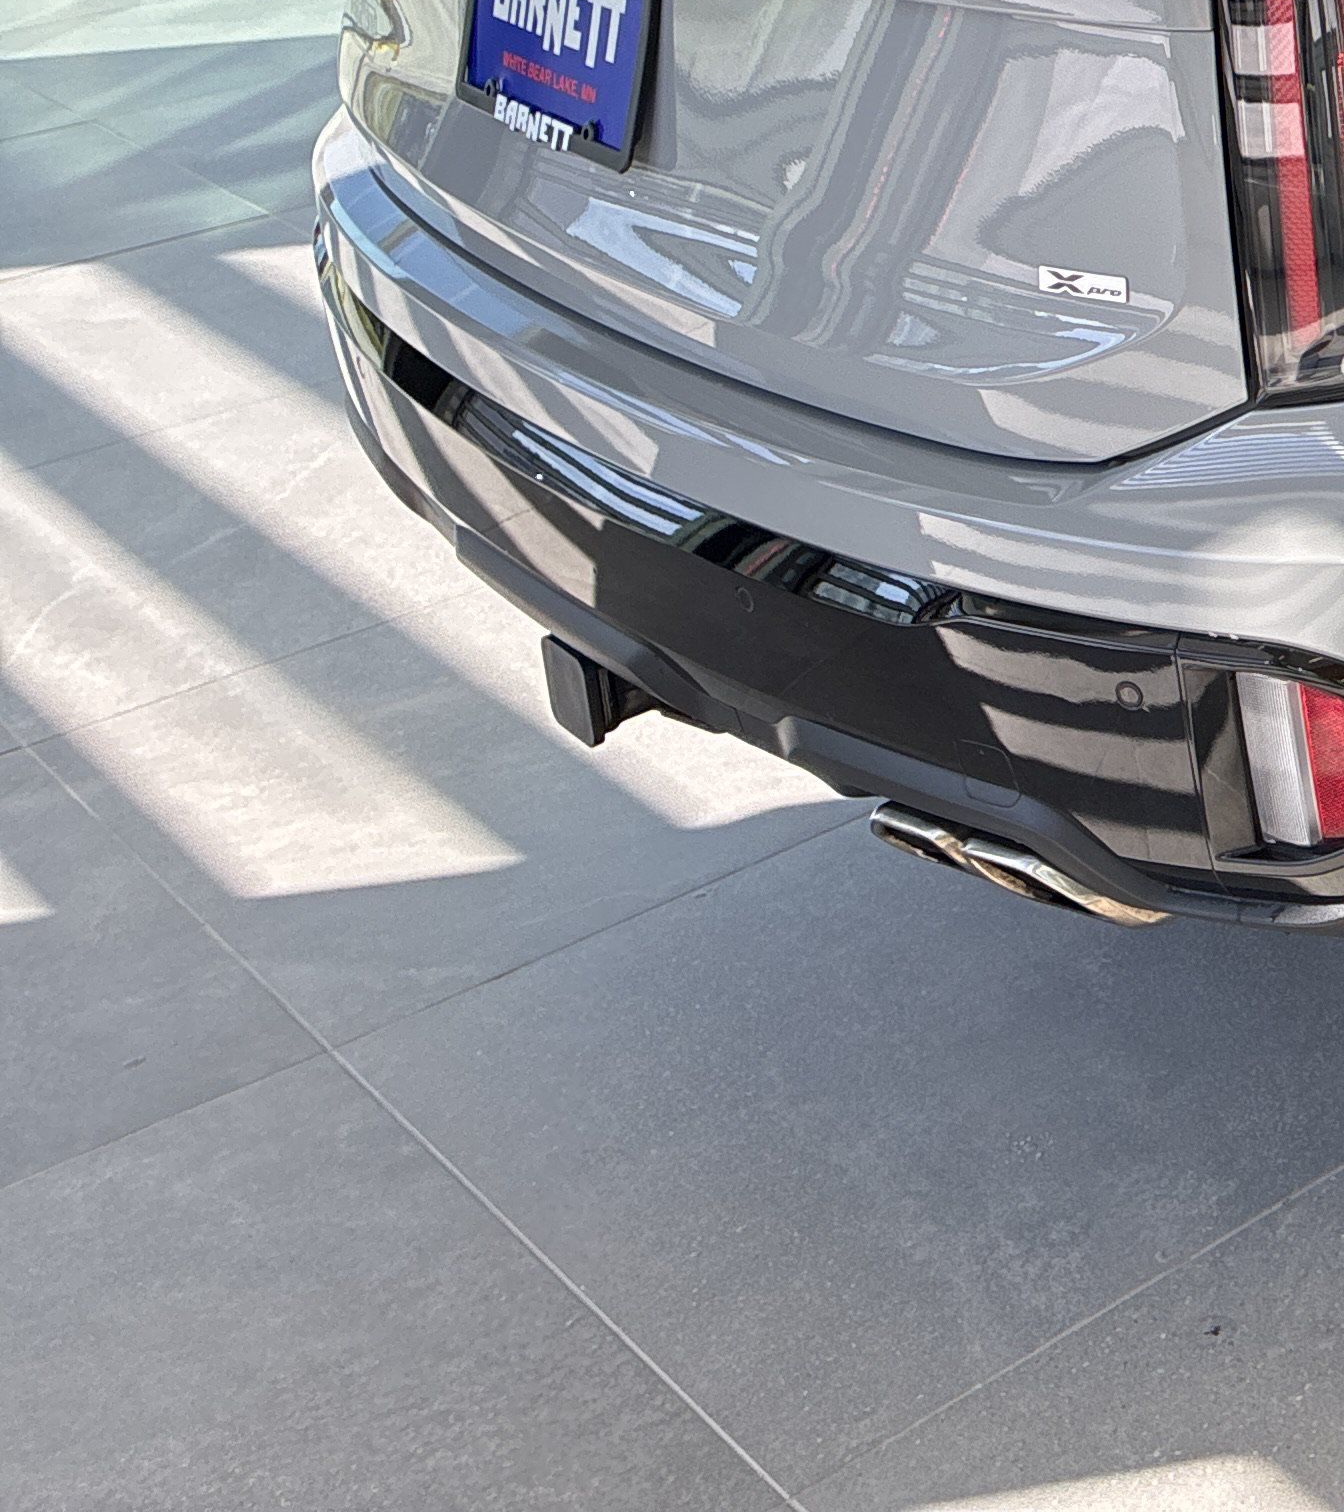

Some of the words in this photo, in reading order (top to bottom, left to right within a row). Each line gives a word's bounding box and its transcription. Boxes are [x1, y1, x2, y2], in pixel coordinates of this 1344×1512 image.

[502, 50, 528, 76] WHITE
[527, 62, 551, 87] BEAR
[493, 93, 574, 152] BARNETT
